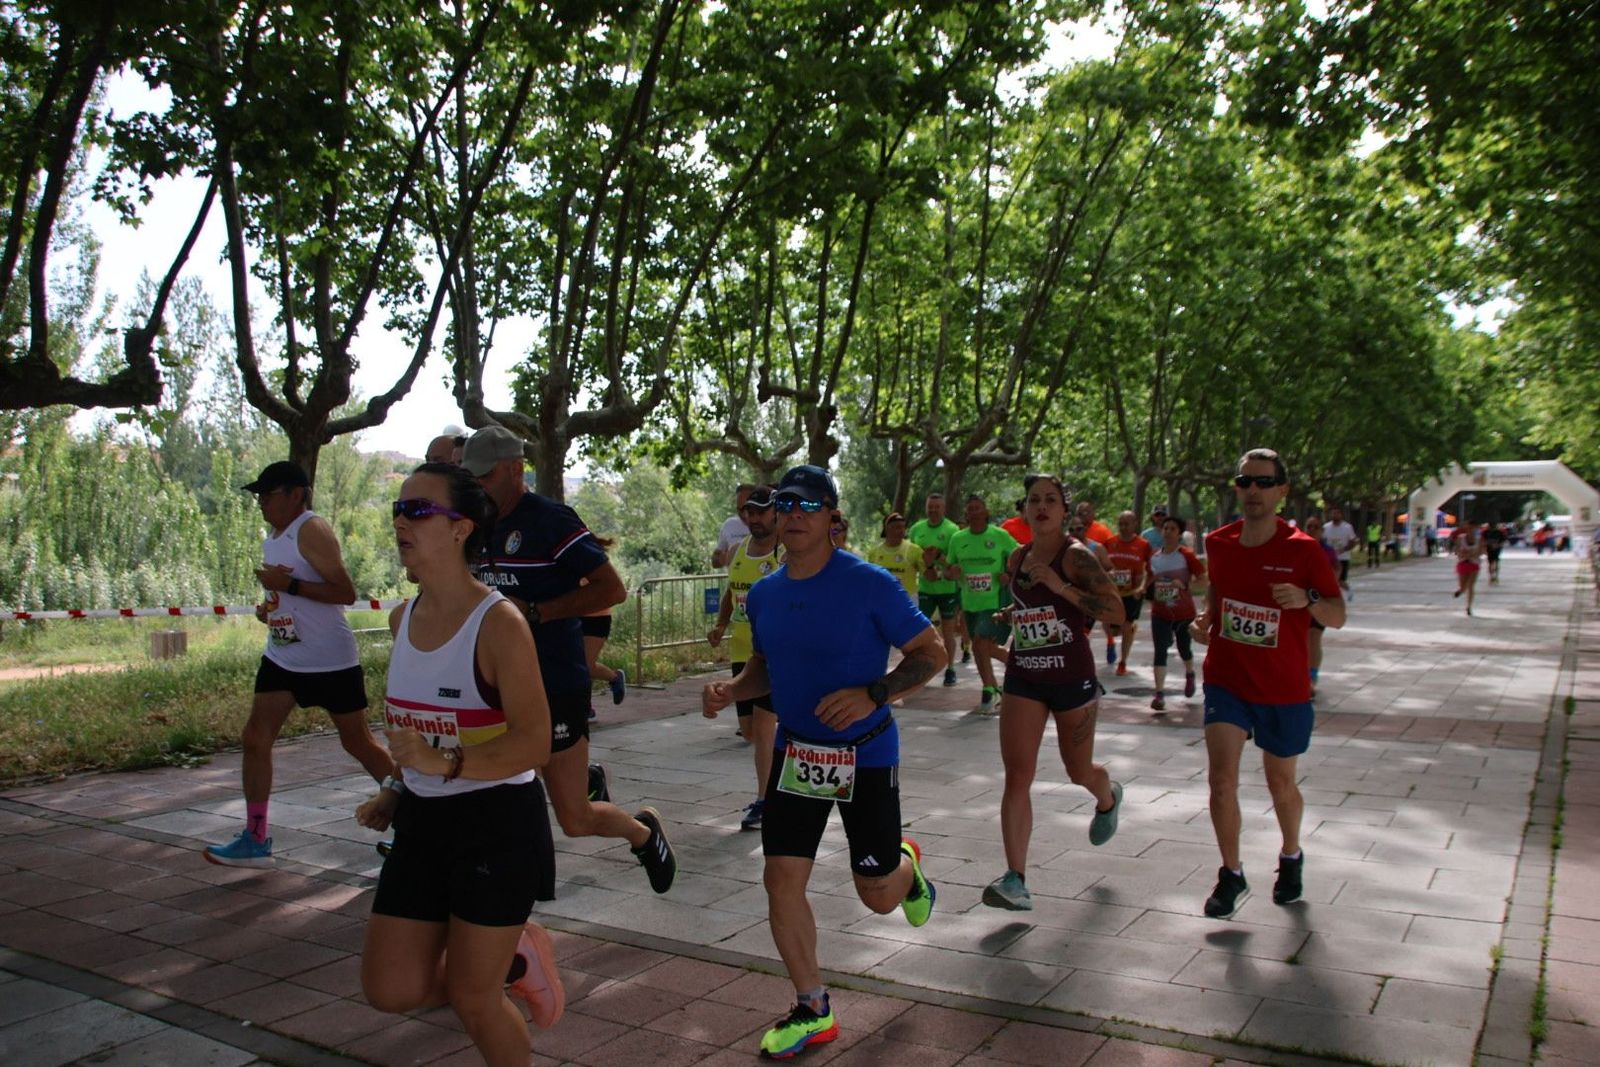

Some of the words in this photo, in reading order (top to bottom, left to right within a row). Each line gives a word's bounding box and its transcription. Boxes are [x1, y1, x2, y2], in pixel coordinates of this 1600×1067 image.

[1020, 622, 1050, 641] 313
[1231, 616, 1266, 637] 368
[386, 705, 457, 737] bedunia
[787, 741, 855, 767] bedunia
[796, 761, 841, 788] 334
